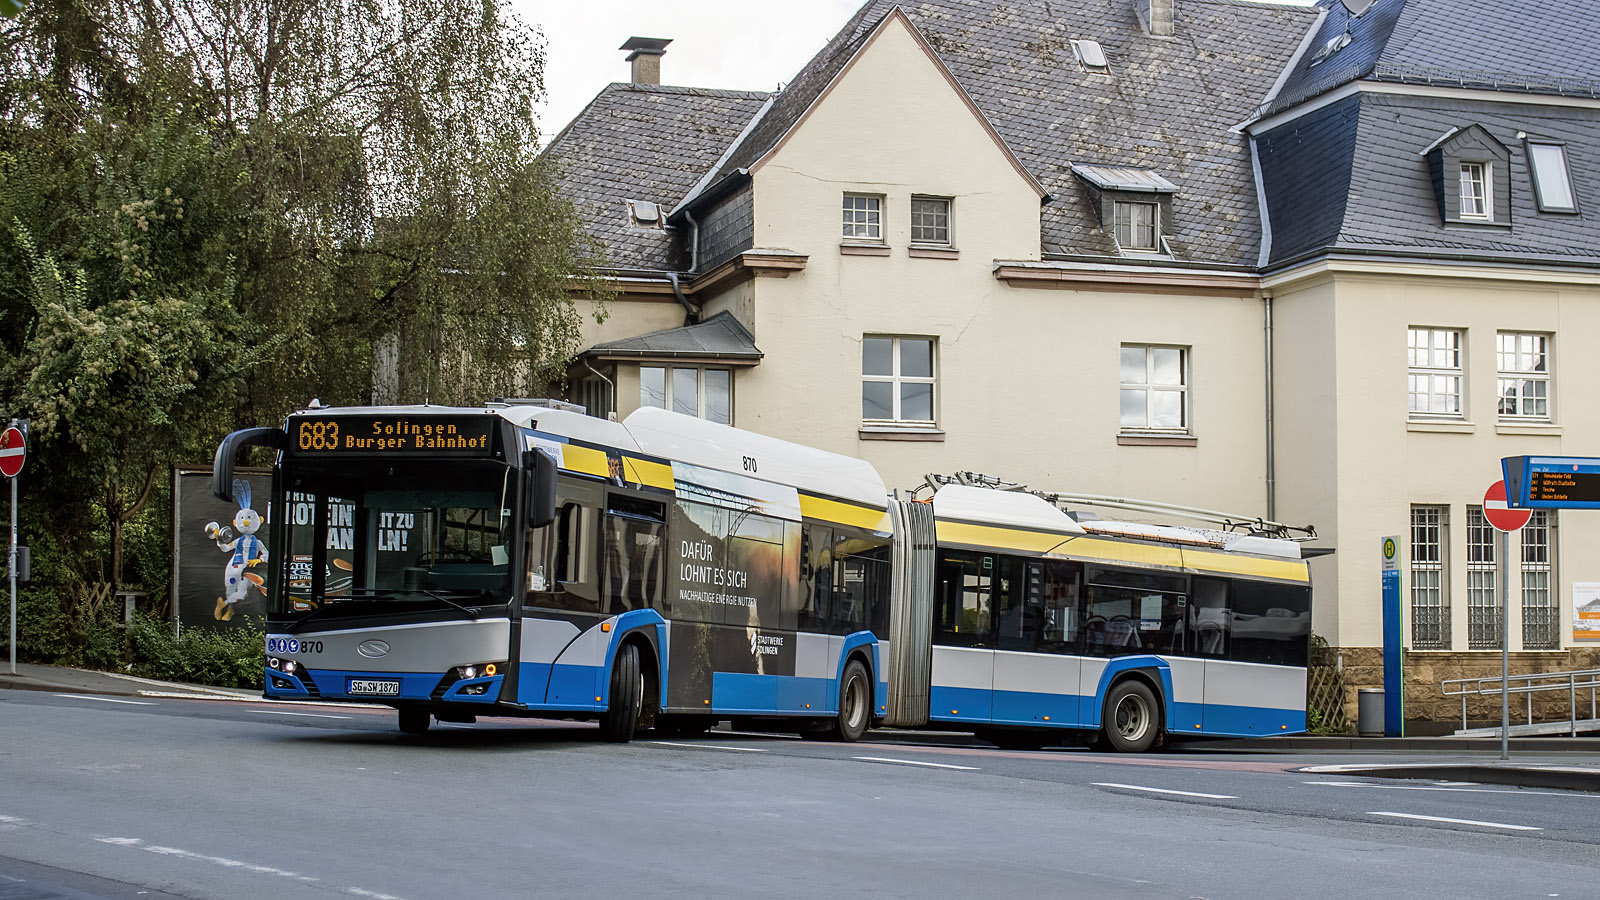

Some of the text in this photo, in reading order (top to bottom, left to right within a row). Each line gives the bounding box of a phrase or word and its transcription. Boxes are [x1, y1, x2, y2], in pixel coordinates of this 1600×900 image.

[300, 422, 339, 450] 683
[373, 422, 457, 436] Solingen
[346, 434, 487, 450] Burger Bahnhof
[742, 455, 758, 473] 870
[396, 512, 414, 530] ZU
[681, 540, 713, 562] DAFÜR
[680, 563, 747, 588] LOHNT ES SICH
[680, 589, 758, 608] NACHHALTIGE ENERGIE NUTZEN
[300, 641, 324, 654] 870
[757, 636, 784, 646] STADTWERKE
[757, 646, 778, 655] SOLINGEN
[352, 681, 363, 691] SG
[379, 682, 398, 693] 1870
